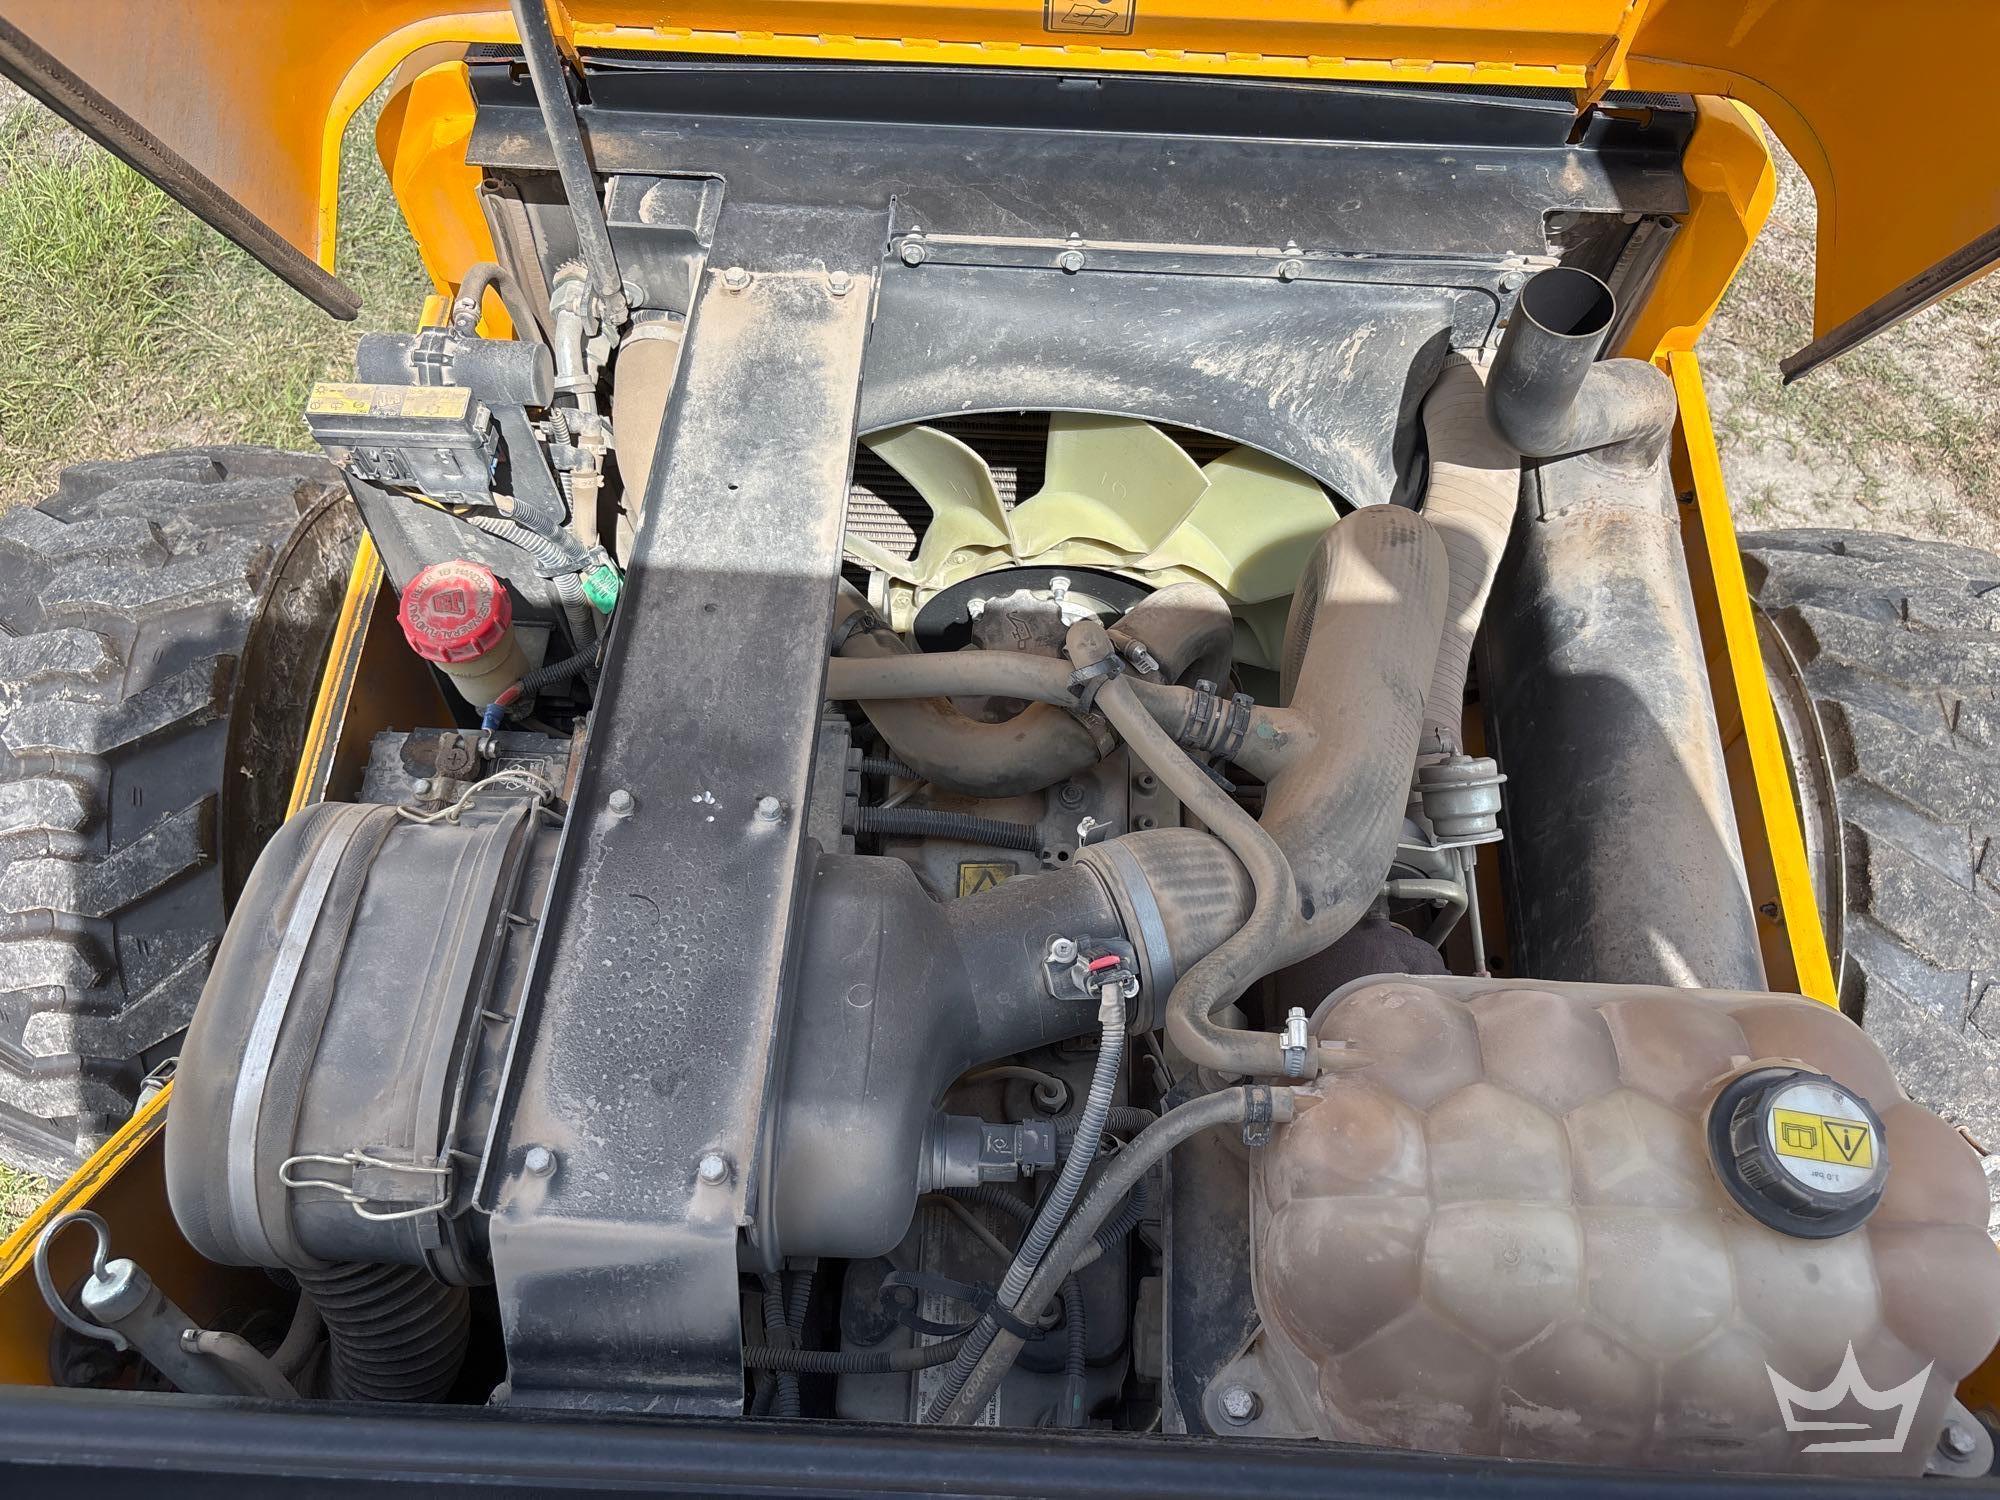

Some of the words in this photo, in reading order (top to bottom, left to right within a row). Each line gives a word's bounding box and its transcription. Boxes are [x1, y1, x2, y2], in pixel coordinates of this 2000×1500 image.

[439, 566, 451, 577] TO
[456, 567, 491, 598] HANDBOOK
[414, 574, 434, 599] REFER
[408, 602, 421, 624] ONLY
[480, 600, 490, 617] USE
[416, 620, 439, 639] FLUID
[444, 613, 483, 638] MINERAL
